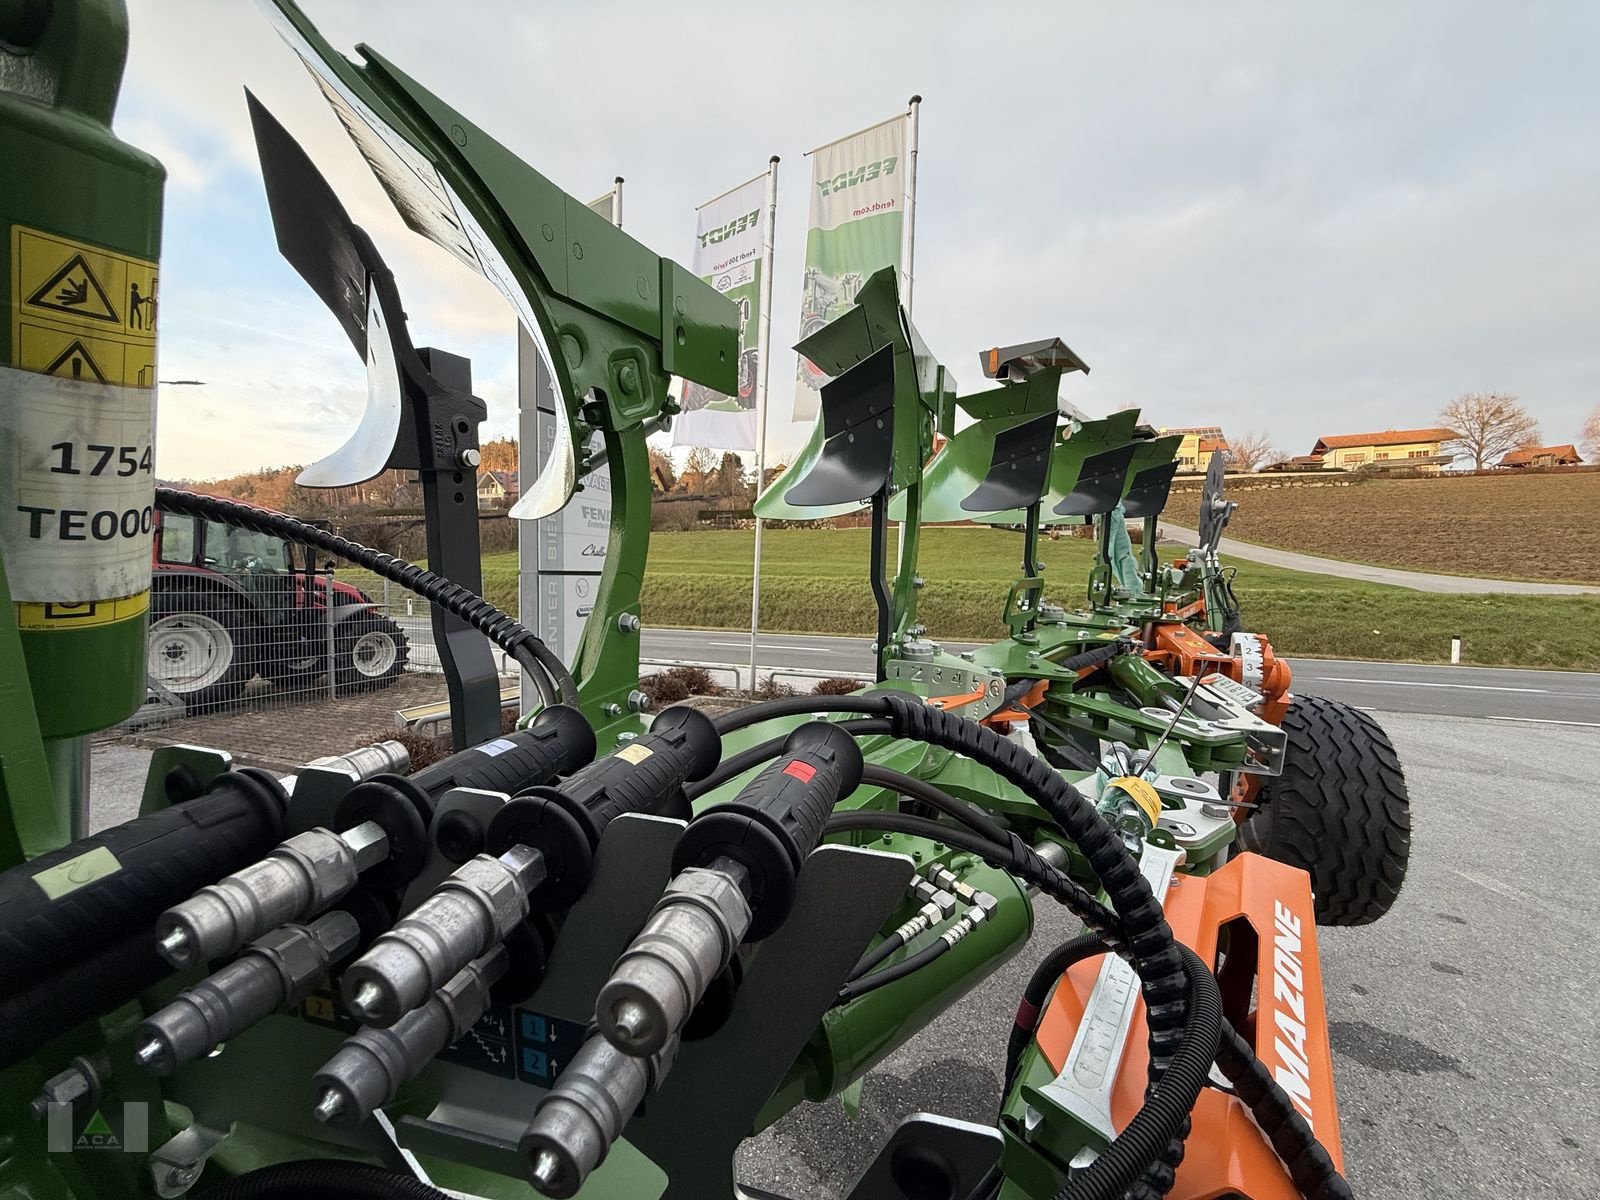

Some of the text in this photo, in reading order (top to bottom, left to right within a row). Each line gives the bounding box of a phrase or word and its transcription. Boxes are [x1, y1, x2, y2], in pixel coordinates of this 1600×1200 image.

[51, 442, 152, 476] 1754
[547, 581, 558, 655] ENTER
[1246, 647, 1252, 655] 2
[1246, 663, 1253, 672] 3
[911, 665, 922, 682] 2
[931, 667, 943, 685] 3
[951, 671, 963, 689] 4
[988, 679, 1000, 698] 6
[529, 1021, 538, 1036] 1
[530, 1053, 540, 1069] 2
